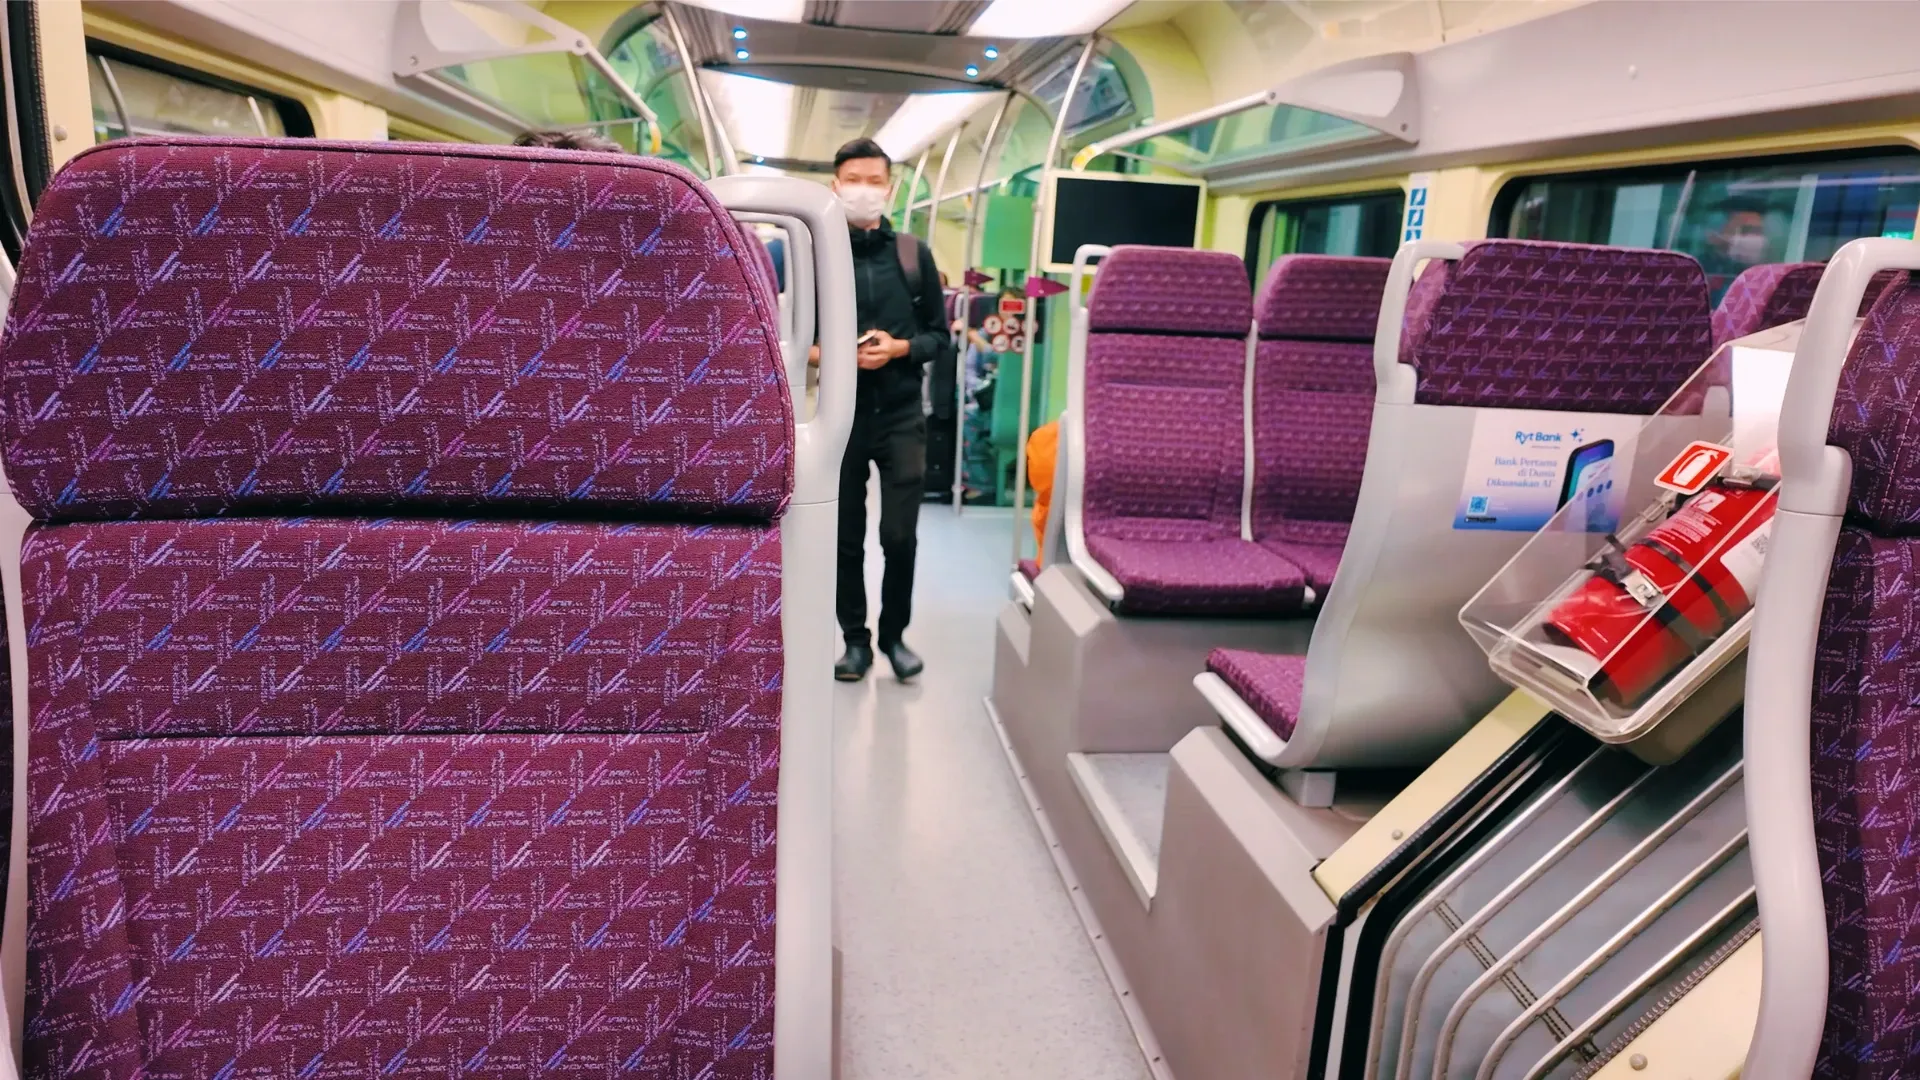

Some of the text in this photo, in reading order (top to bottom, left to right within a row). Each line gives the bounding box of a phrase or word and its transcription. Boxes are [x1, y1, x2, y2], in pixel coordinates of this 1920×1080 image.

[1515, 431, 1562, 445] Ryt Bank
[1495, 456, 1558, 468] Bank Pertama
